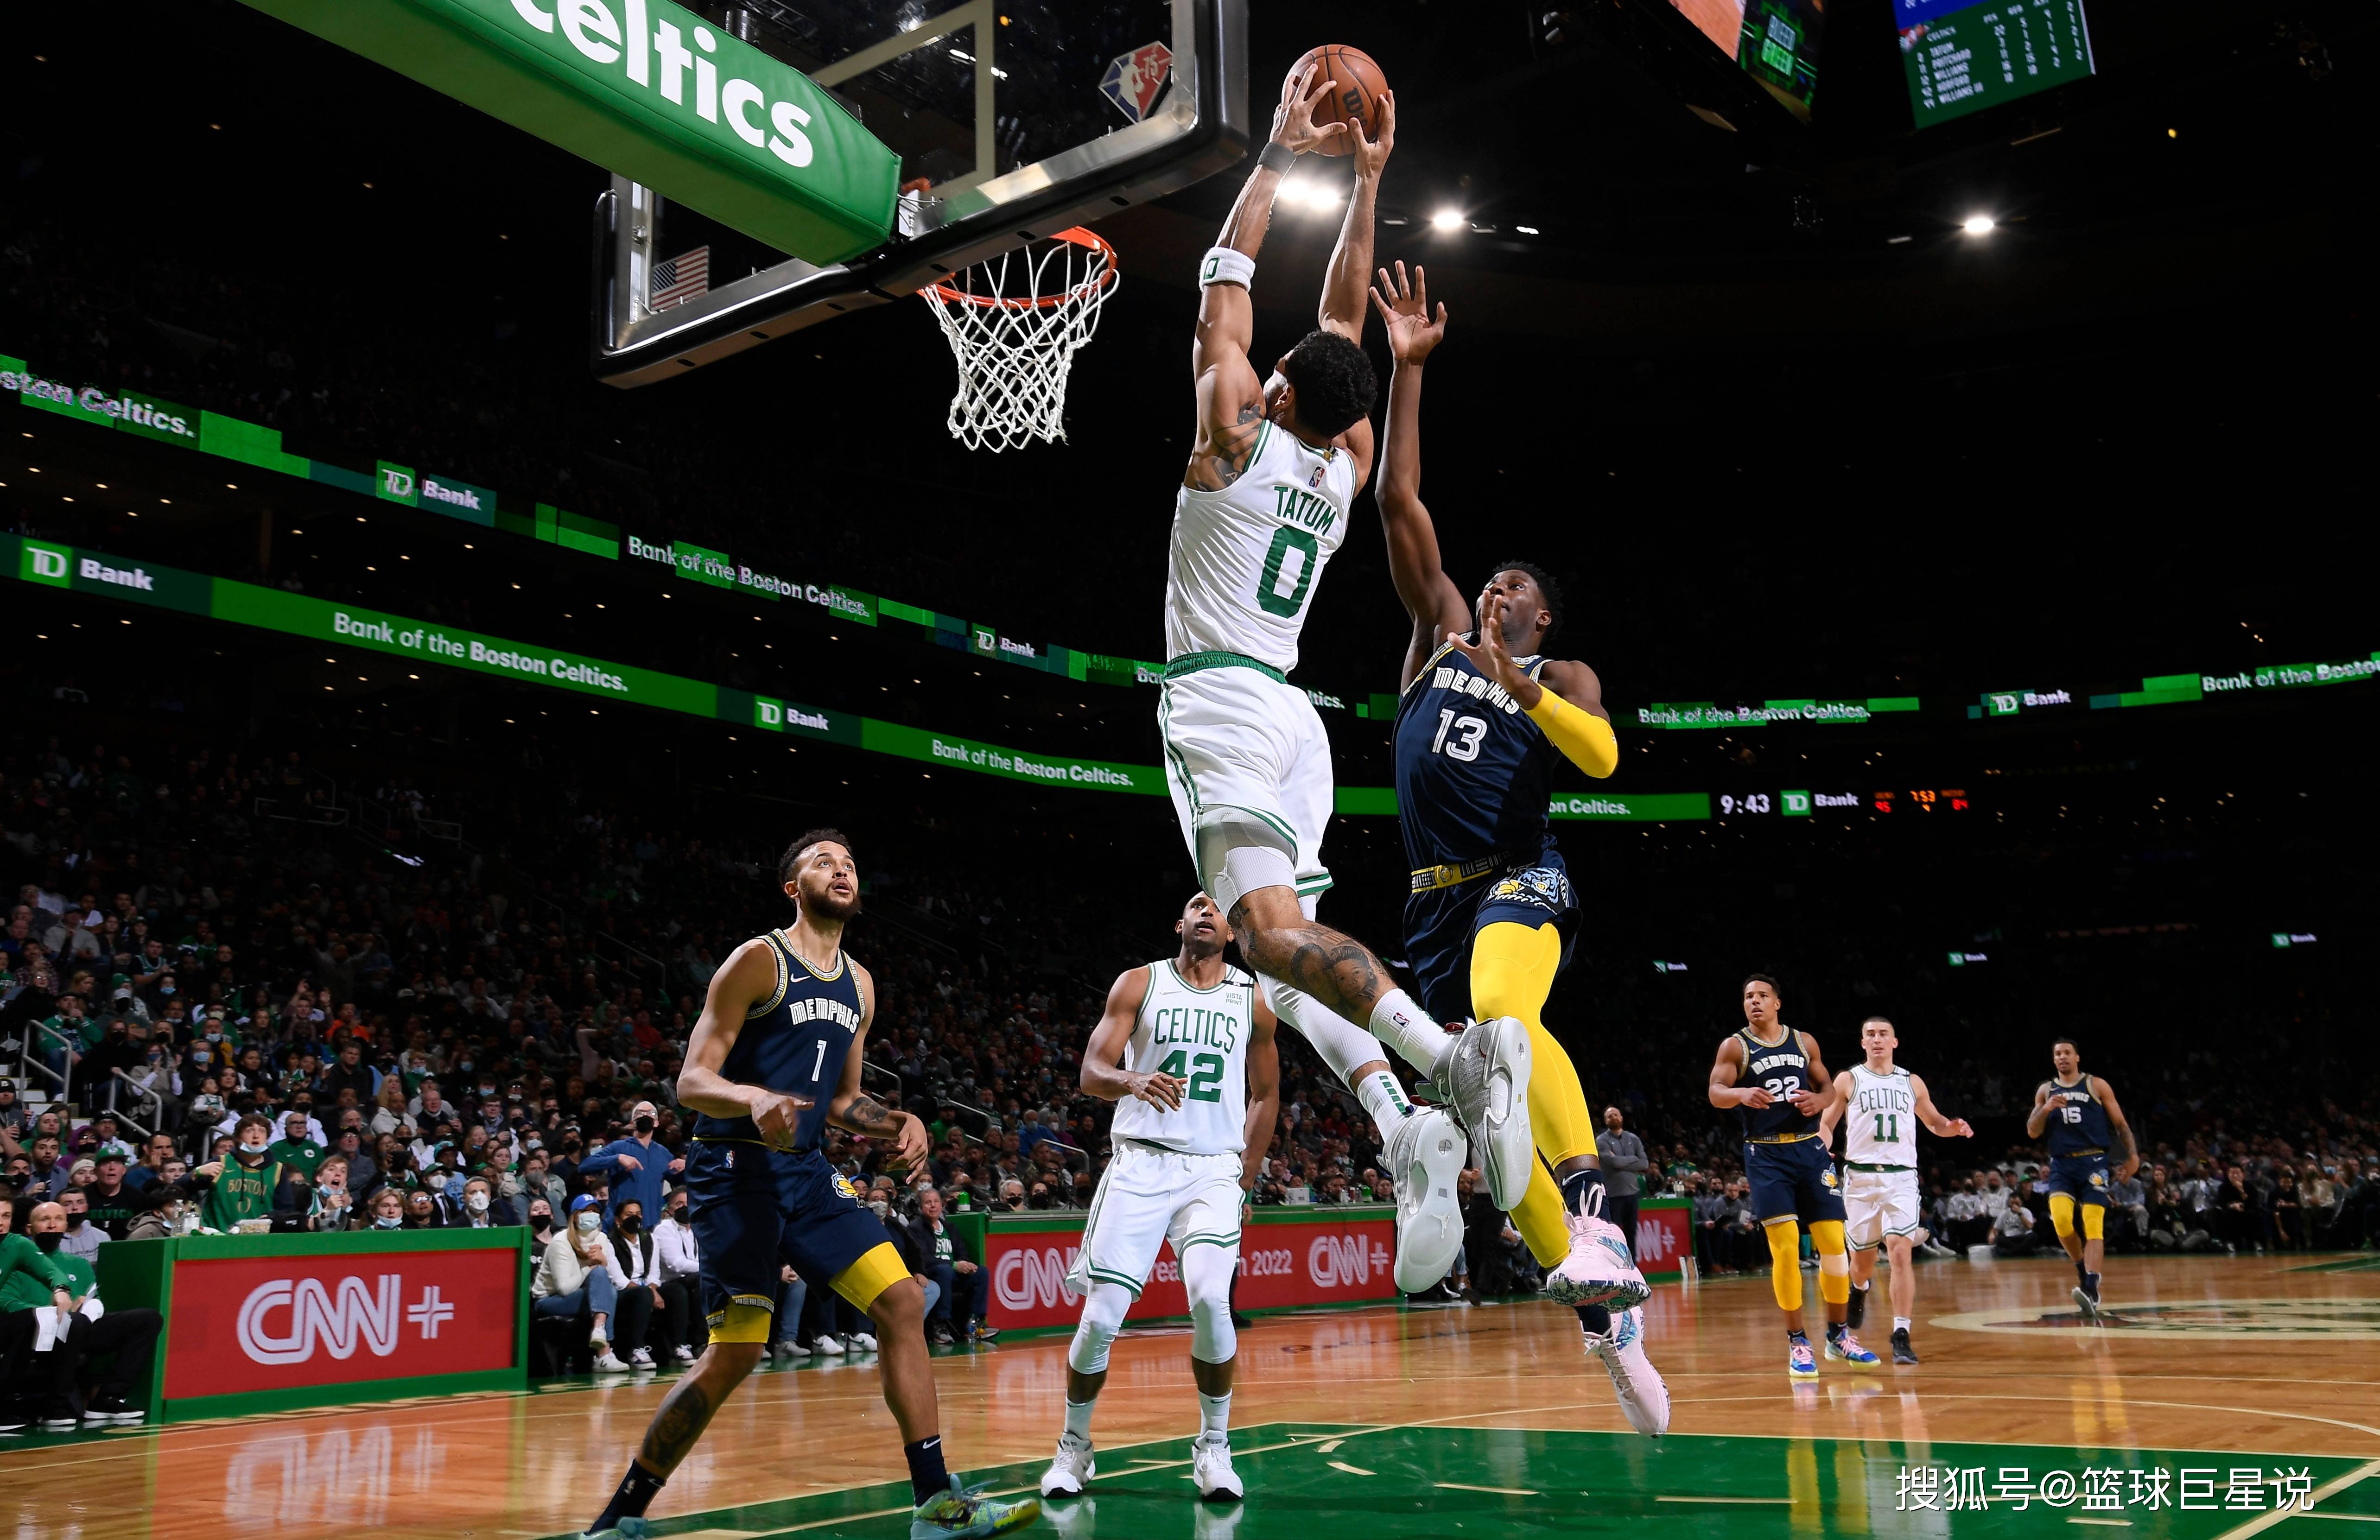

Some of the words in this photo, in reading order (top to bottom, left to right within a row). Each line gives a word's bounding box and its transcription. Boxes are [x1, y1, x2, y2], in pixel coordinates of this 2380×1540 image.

[0, 371, 73, 406] ston
[78, 387, 196, 438] Celtics.
[382, 468, 414, 496] TD
[422, 479, 481, 511] Bank
[1274, 486, 1338, 537] TATUM
[27, 546, 65, 578] TD
[80, 558, 154, 592] Bank
[628, 535, 677, 566] Bank
[681, 552, 700, 571] of
[704, 558, 735, 581] the
[738, 565, 803, 599] Boston
[805, 583, 869, 617] Celtics.
[1257, 524, 1318, 619] 0
[335, 612, 394, 644] Bank
[400, 629, 424, 649] of
[427, 634, 465, 658] the
[470, 641, 547, 675] Boston
[550, 659, 628, 691] Celtics.
[1000, 636, 1035, 658] Bank
[1137, 667, 1163, 684] Ba
[2202, 672, 2252, 691] Bank
[2254, 671, 2275, 686] of
[2280, 668, 2312, 684] the
[1307, 689, 1345, 709] ltics.
[1432, 666, 1521, 715] MEMPHIS
[2023, 689, 2071, 706] Bank
[757, 702, 779, 724] TD
[787, 708, 829, 731] Bank
[1638, 708, 1680, 723] Bank
[1684, 707, 1701, 723] of
[1705, 707, 1734, 722] the
[1432, 708, 1487, 762] 13
[933, 739, 969, 764] Bank
[971, 748, 987, 766] of
[989, 750, 1011, 770] the
[1014, 756, 1067, 780] Boston
[1069, 765, 1134, 787] Celtics.
[1569, 799, 1631, 815] Celtics.
[1720, 794, 1770, 814] 9:43
[1783, 795, 1808, 811] TD
[1815, 792, 1859, 808] Bank
[1226, 992, 1242, 1001] VISTA
[789, 998, 860, 1034] MEMPHIS
[1155, 1008, 1238, 1054] CELTICS
[811, 1039, 827, 1082] 1
[1751, 1053, 1805, 1075] MEMPHIS
[1157, 1049, 1225, 1103] 42
[1765, 1076, 1800, 1102] 22
[1860, 1087, 1910, 1114] CELTICS
[2057, 1092, 2090, 1103] MPHIS
[1873, 1113, 1900, 1143] 11
[2061, 1107, 2082, 1125] 15
[228, 1179, 267, 1197] BOSTON
[88, 1209, 134, 1219] ELTICS
[1251, 1249, 1293, 1276] 2022
